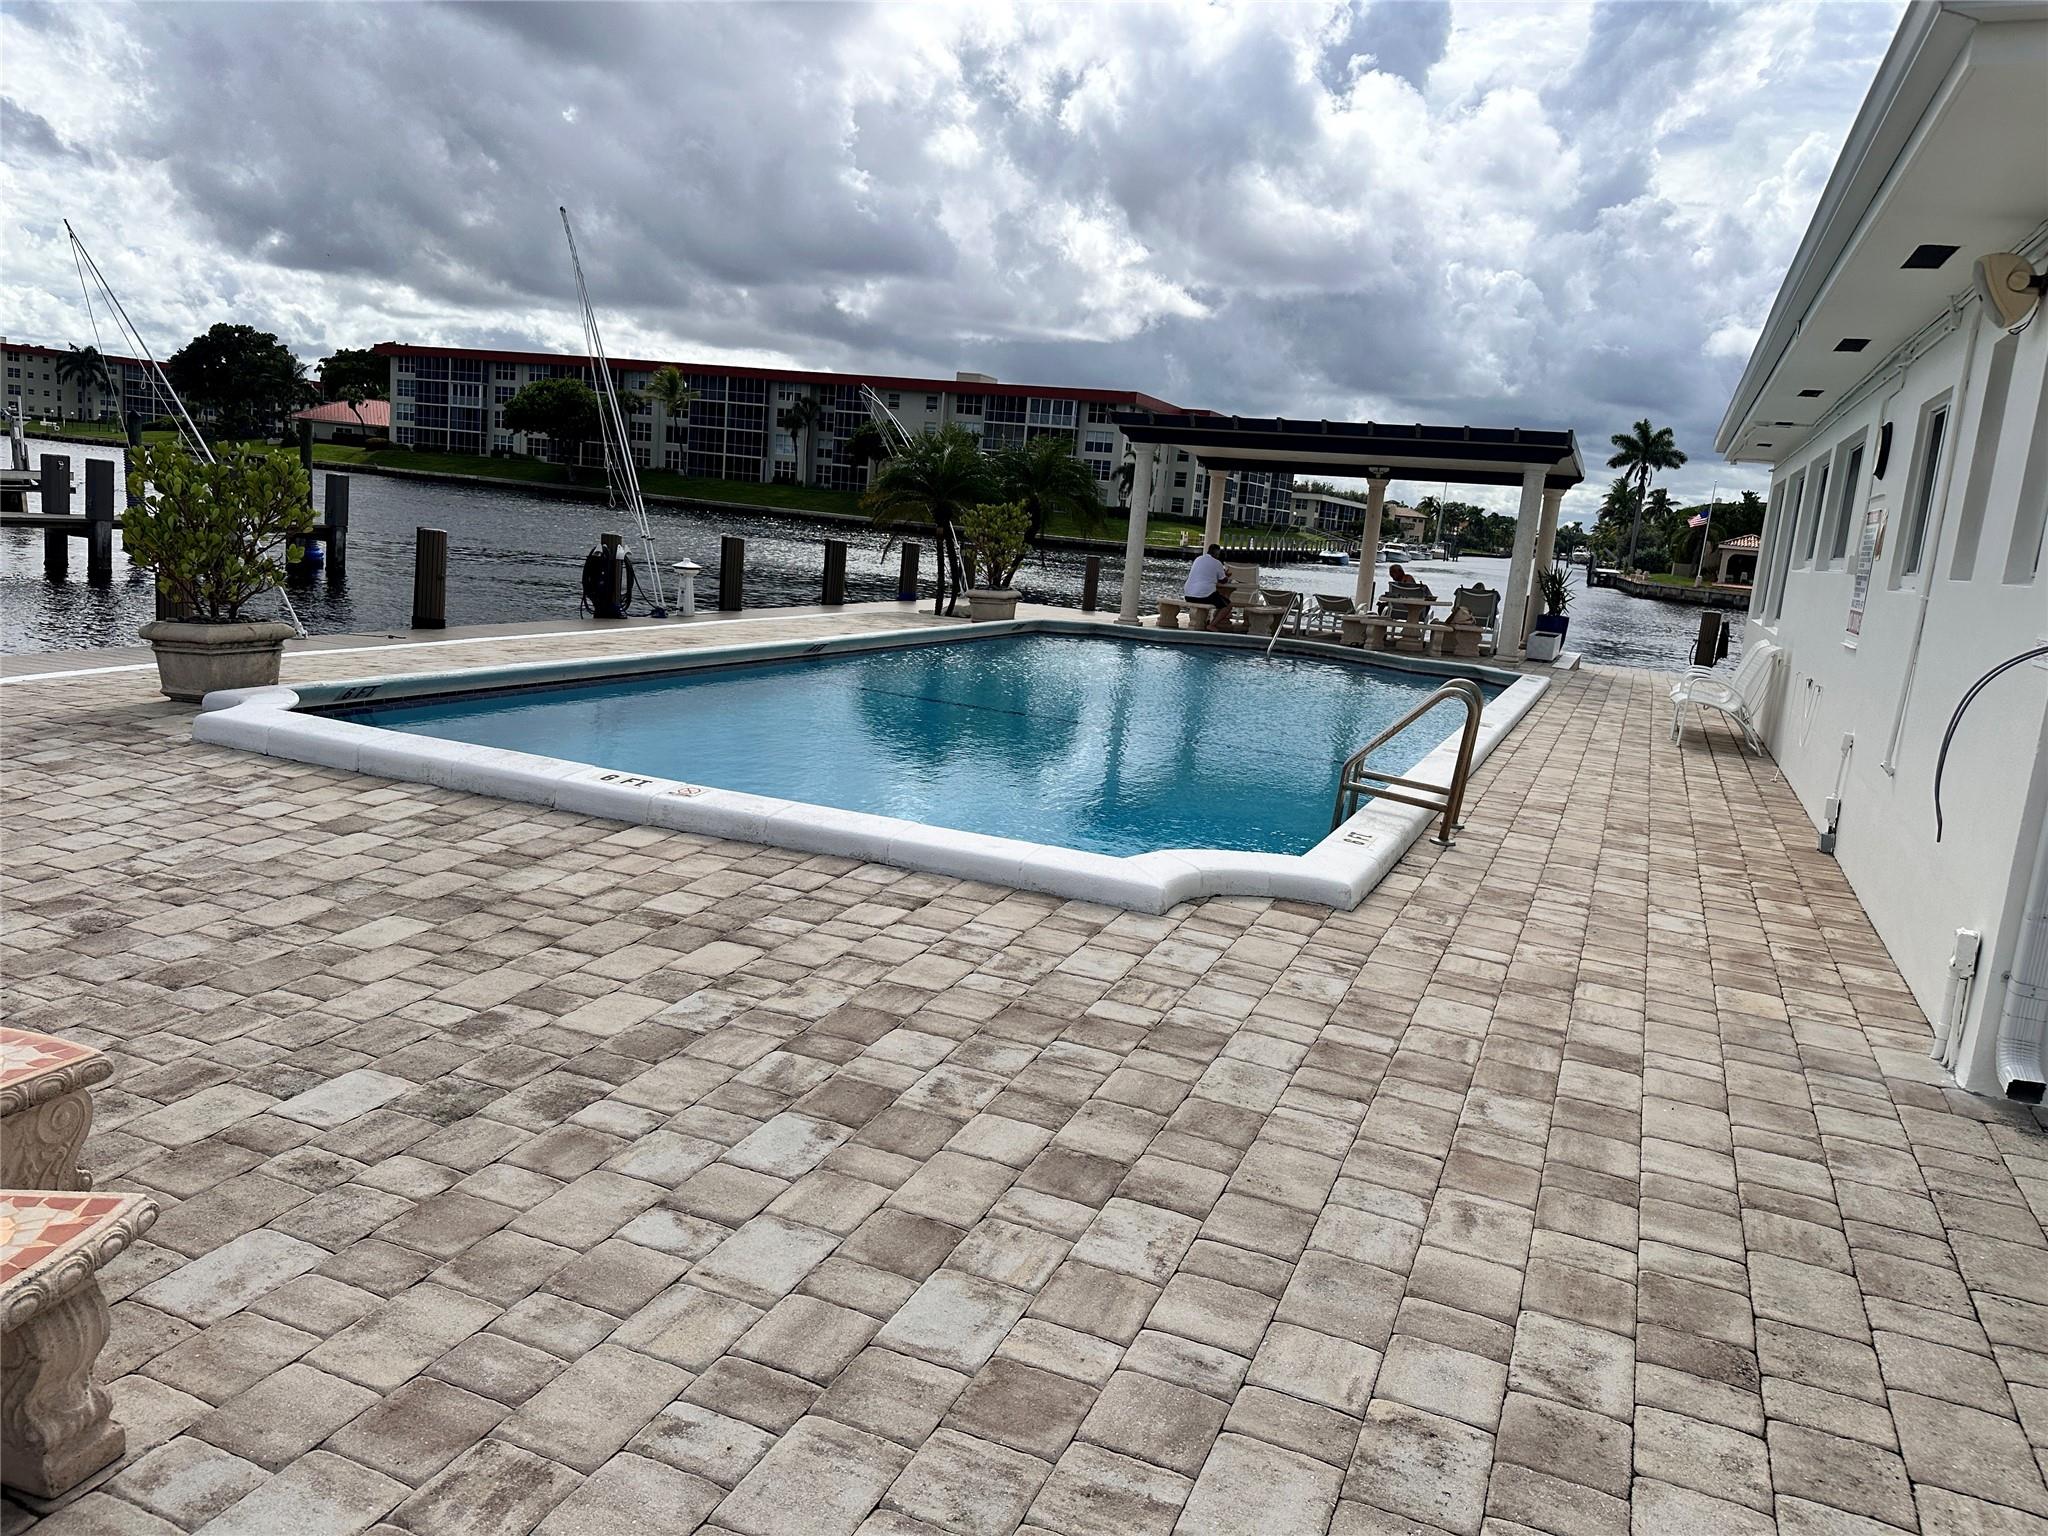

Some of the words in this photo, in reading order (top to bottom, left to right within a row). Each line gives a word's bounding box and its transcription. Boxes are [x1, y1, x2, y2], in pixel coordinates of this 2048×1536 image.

[342, 687, 356, 700] 6
[353, 685, 381, 699] FT
[620, 777, 653, 786] FT
